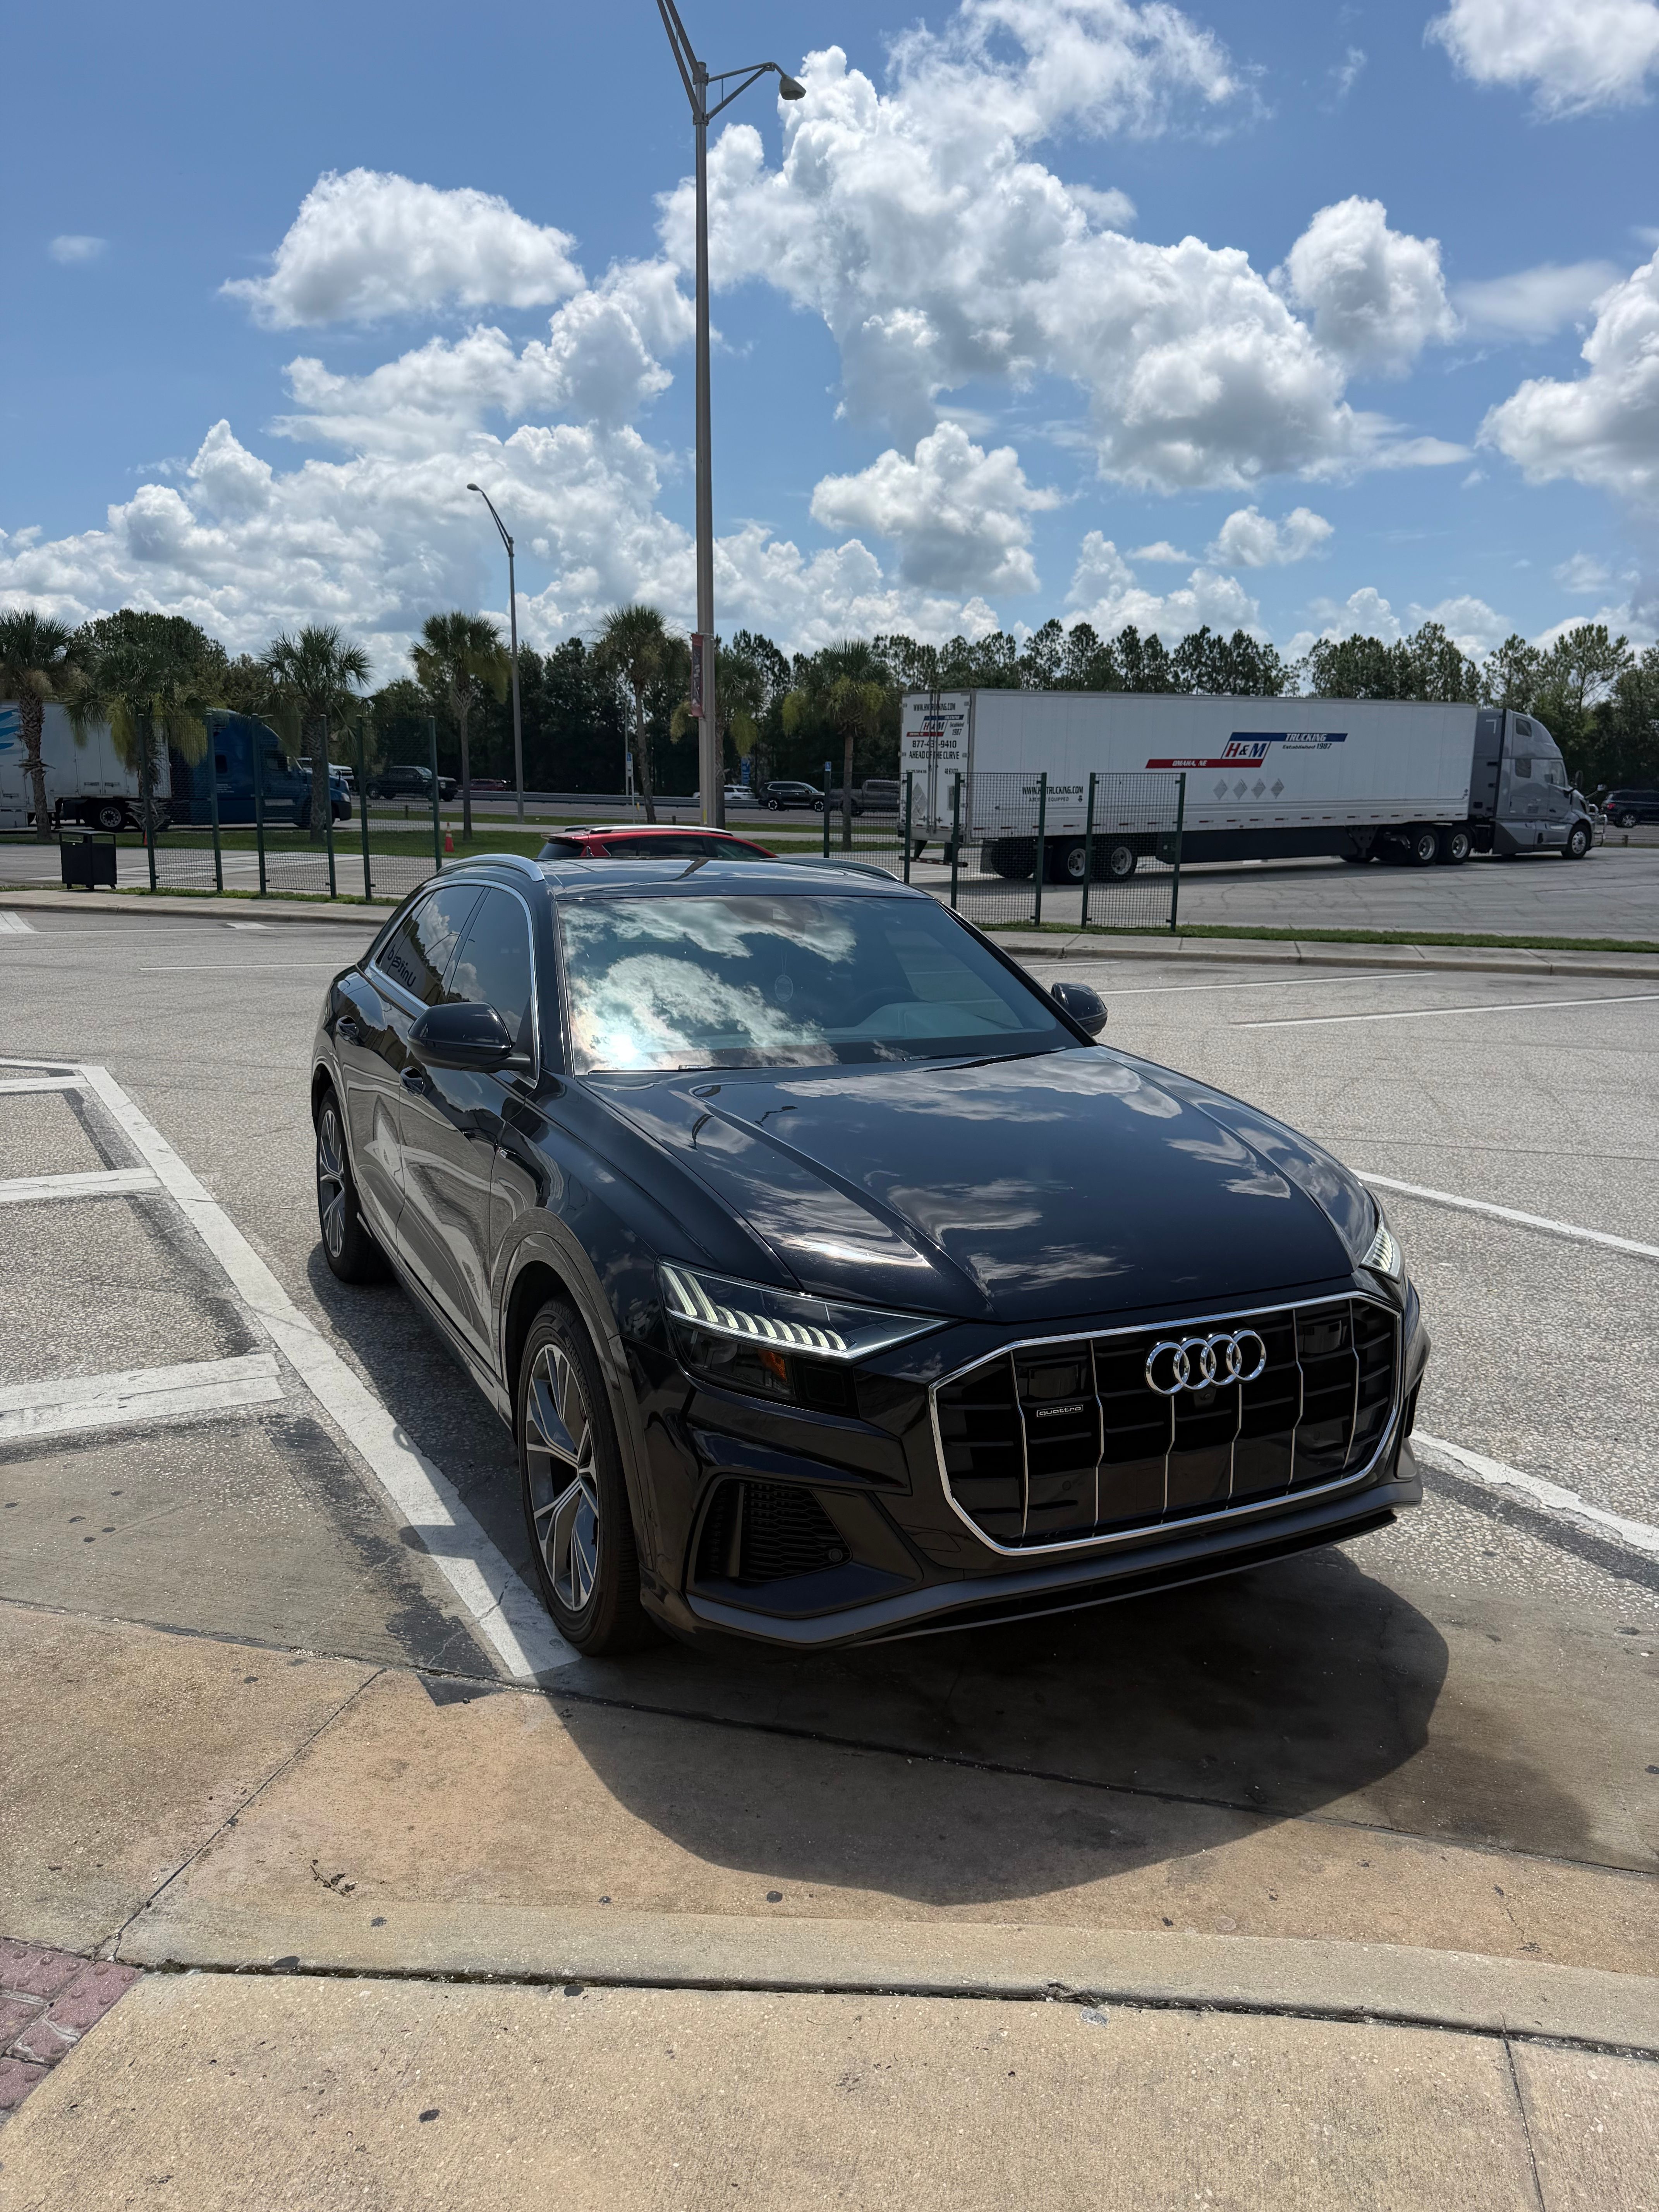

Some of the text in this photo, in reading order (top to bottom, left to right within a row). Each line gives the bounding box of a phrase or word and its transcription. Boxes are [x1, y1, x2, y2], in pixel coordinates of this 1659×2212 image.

[1285, 733, 1328, 742] TRUCKING
[909, 750, 925, 759] AHEAD
[943, 751, 960, 759] CURVE
[1022, 786, 1083, 794] WWW.HTRUCKING.COM
[1039, 1406, 1081, 1416] quattro
